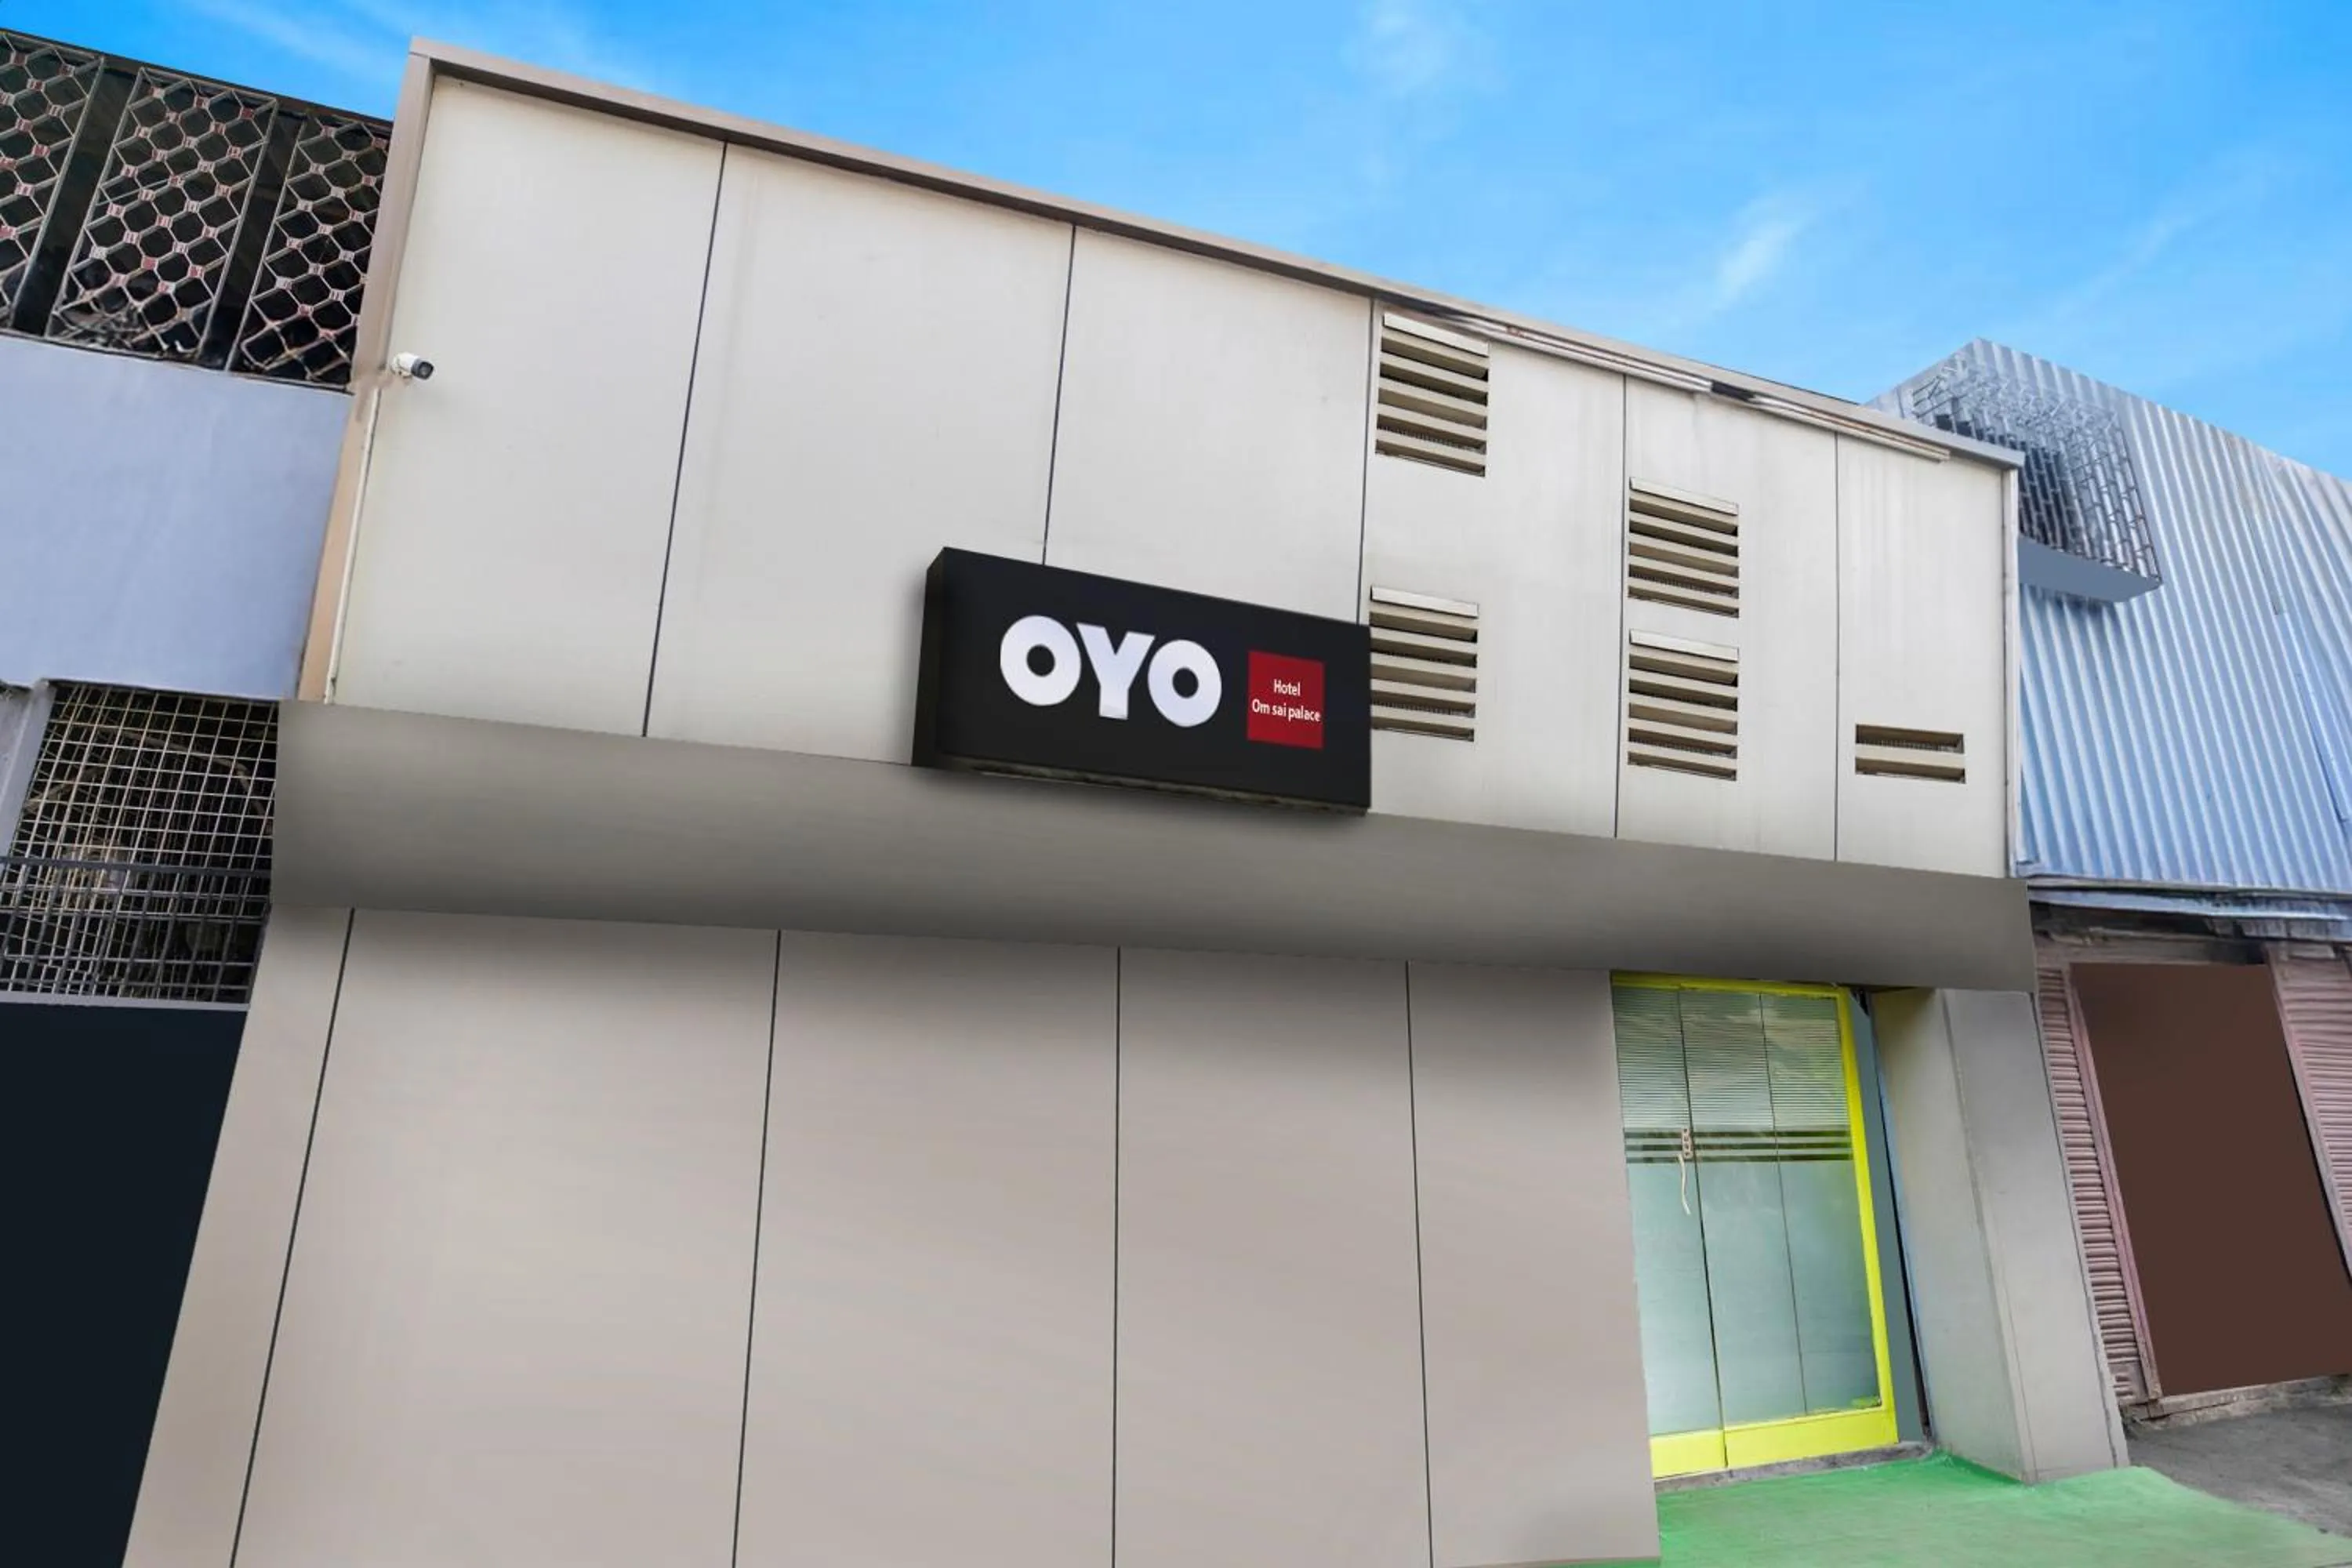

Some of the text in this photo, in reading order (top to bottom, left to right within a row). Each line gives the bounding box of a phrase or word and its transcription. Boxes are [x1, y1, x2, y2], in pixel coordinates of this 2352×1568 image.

[999, 615, 1223, 728] OYO
[1273, 679, 1301, 696] Hotel
[1252, 699, 1321, 722] Om sai palace
